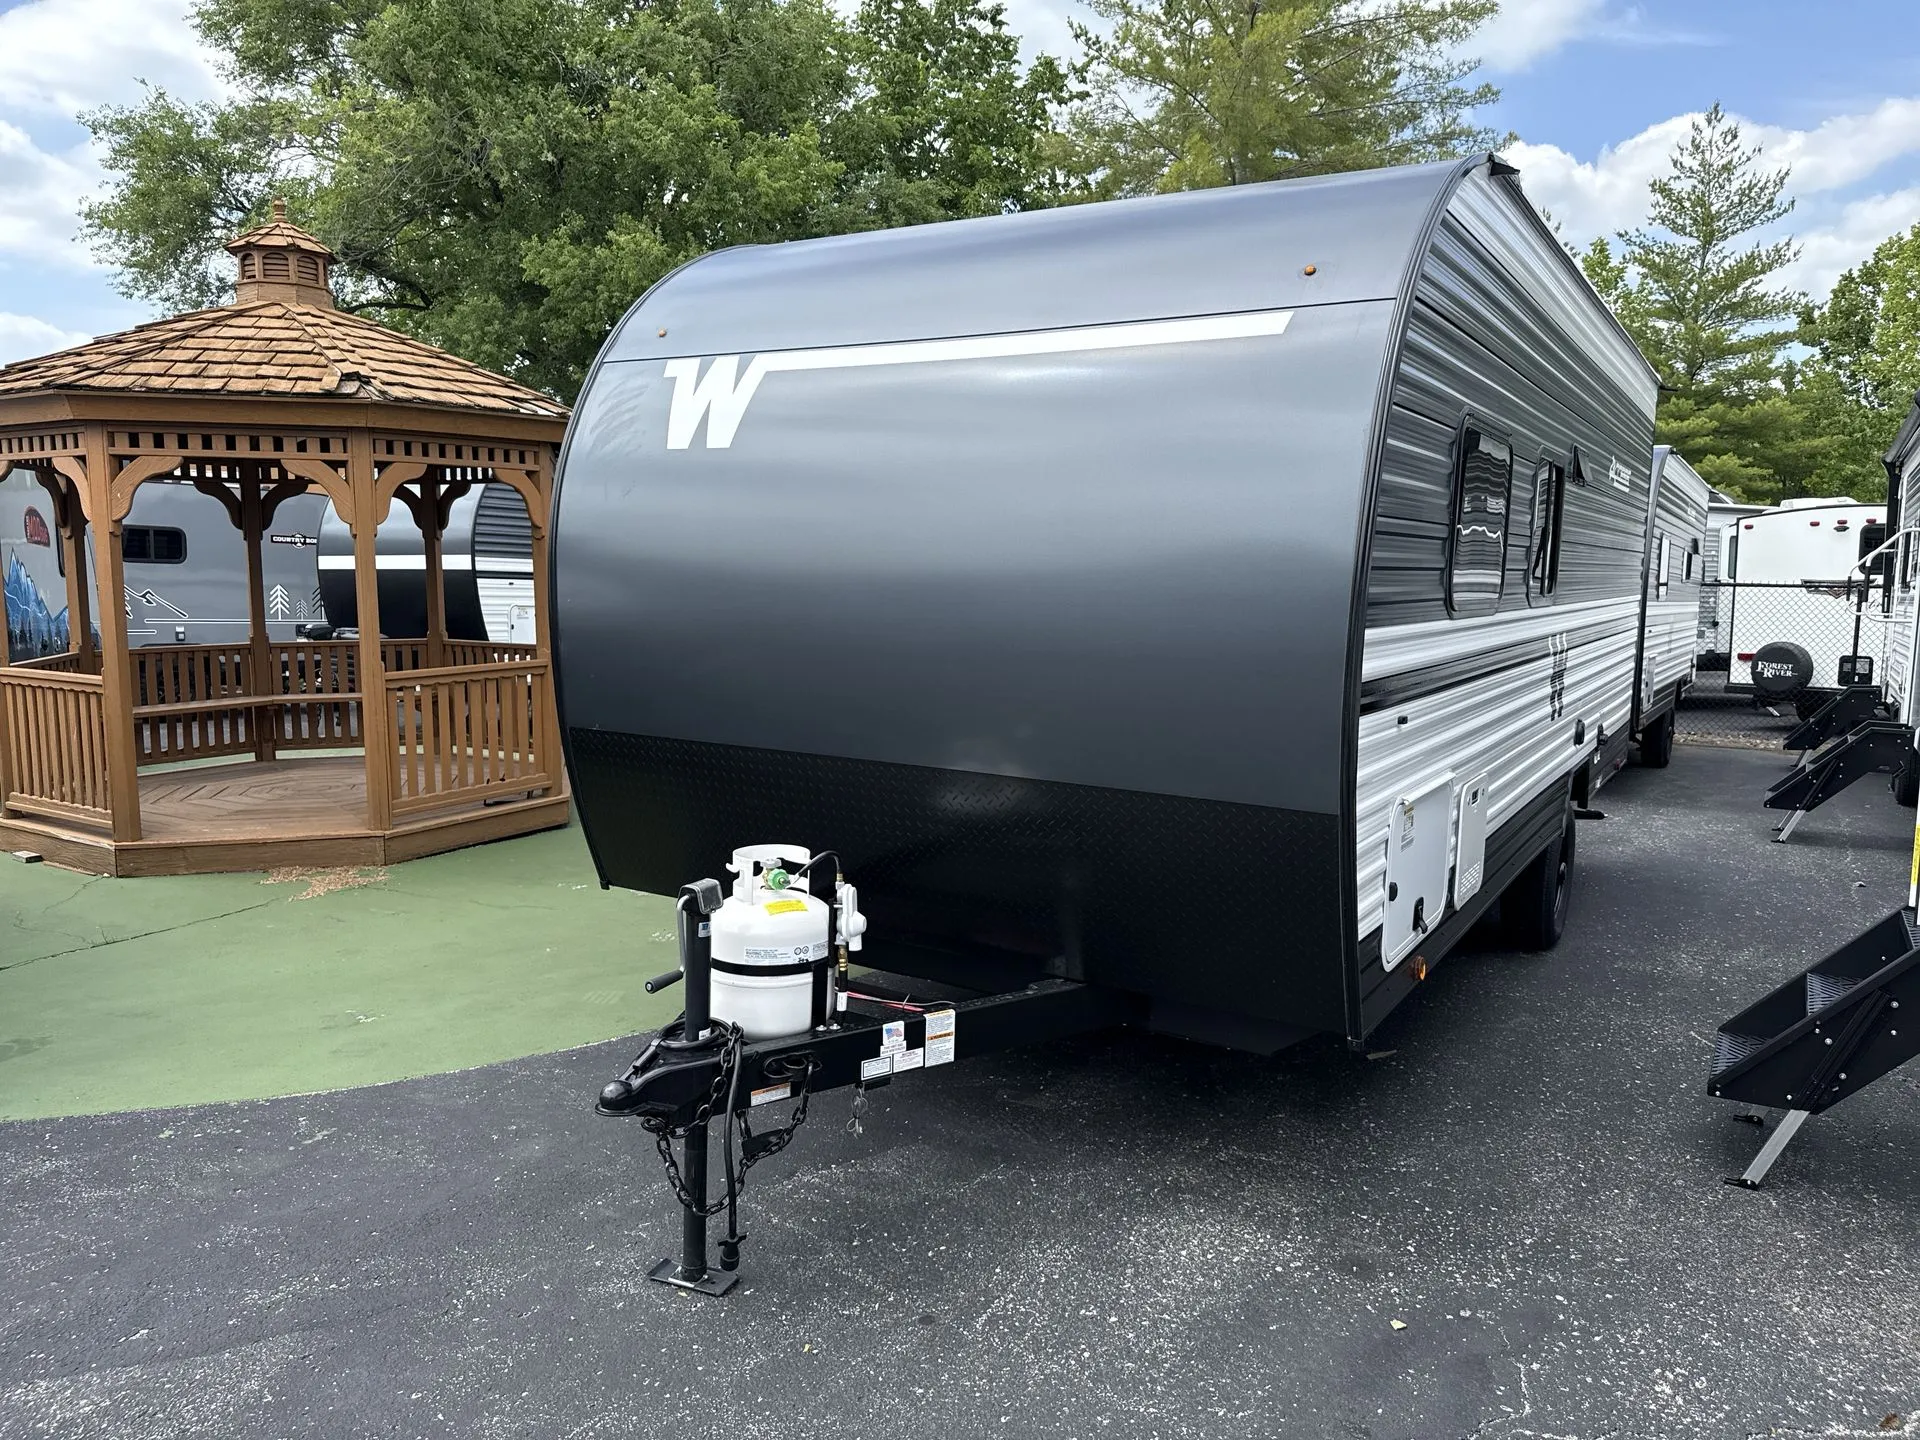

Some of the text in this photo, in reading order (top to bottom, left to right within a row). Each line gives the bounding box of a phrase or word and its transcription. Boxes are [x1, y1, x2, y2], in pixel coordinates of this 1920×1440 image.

[663, 352, 768, 450] W
[1755, 660, 1794, 673] FOREST
[1762, 667, 1793, 679] RIVER
